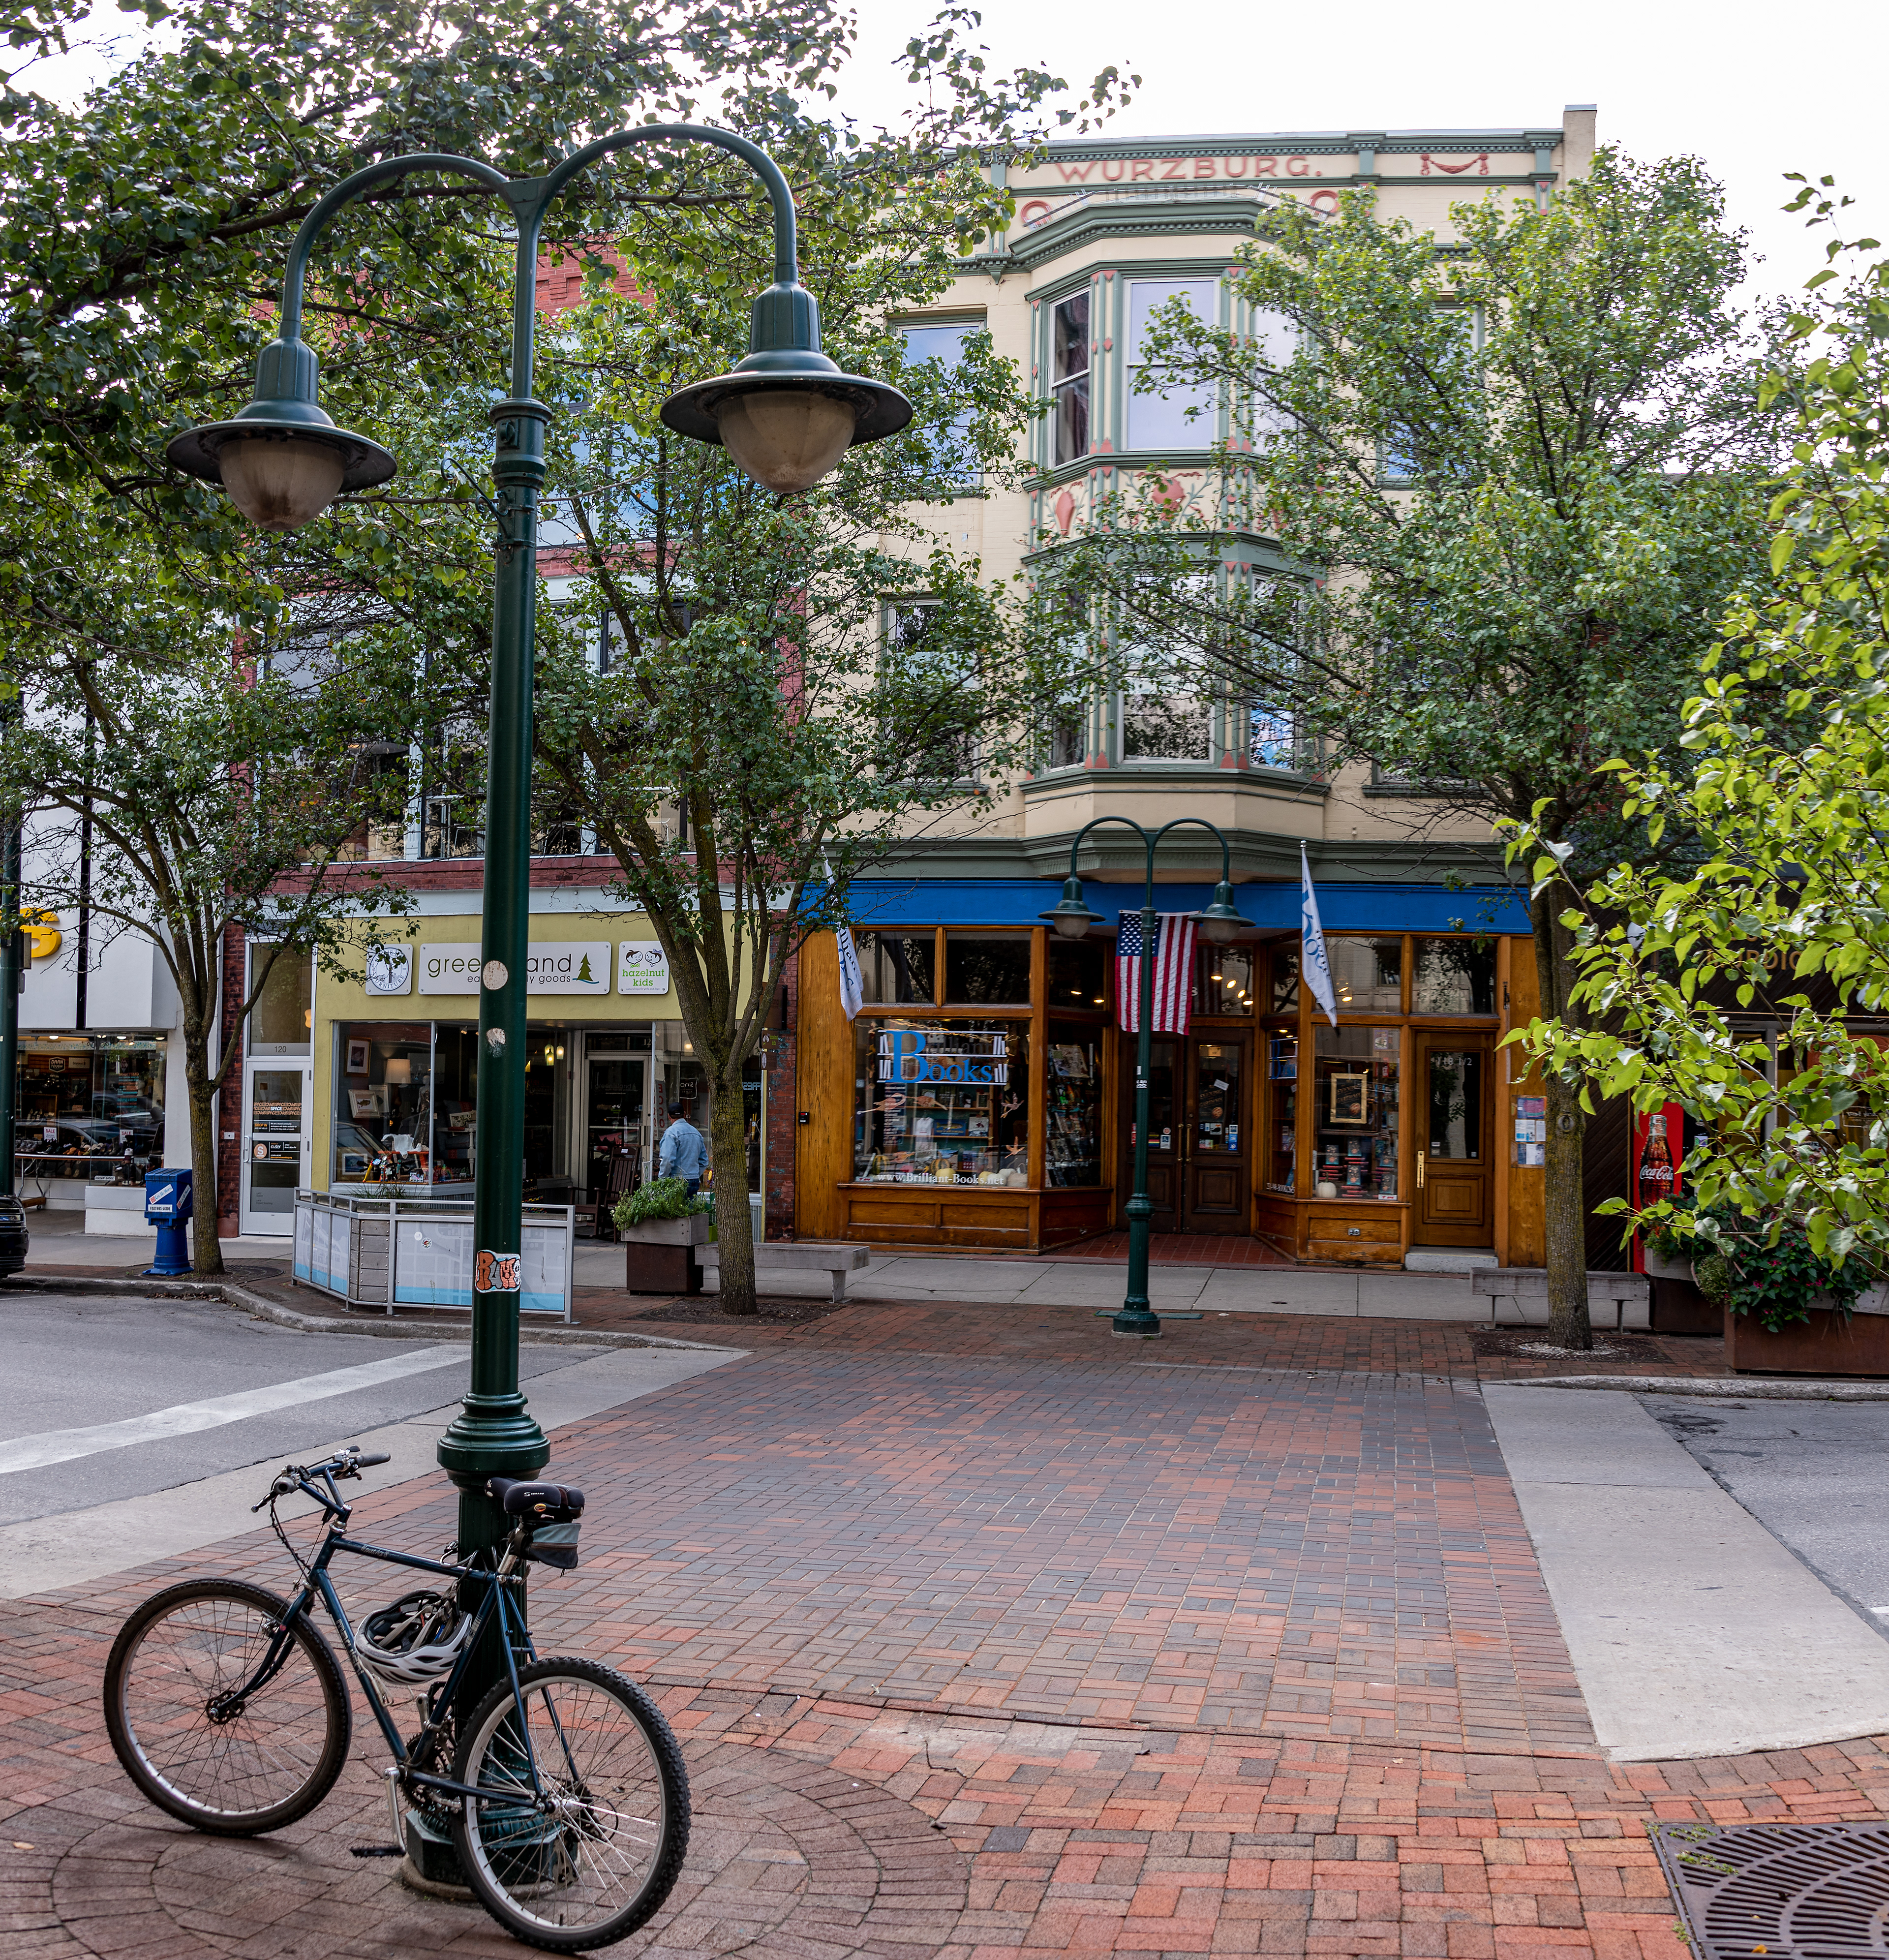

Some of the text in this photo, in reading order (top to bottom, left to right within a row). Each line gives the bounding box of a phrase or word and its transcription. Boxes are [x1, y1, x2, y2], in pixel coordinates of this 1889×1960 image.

[372, 975, 405, 989] URNITURE
[539, 974, 571, 984] goods
[885, 1031, 993, 1083] Books
[258, 1146, 264, 1155] S
[877, 1172, 1004, 1185] www.Brilliant-Books.net
